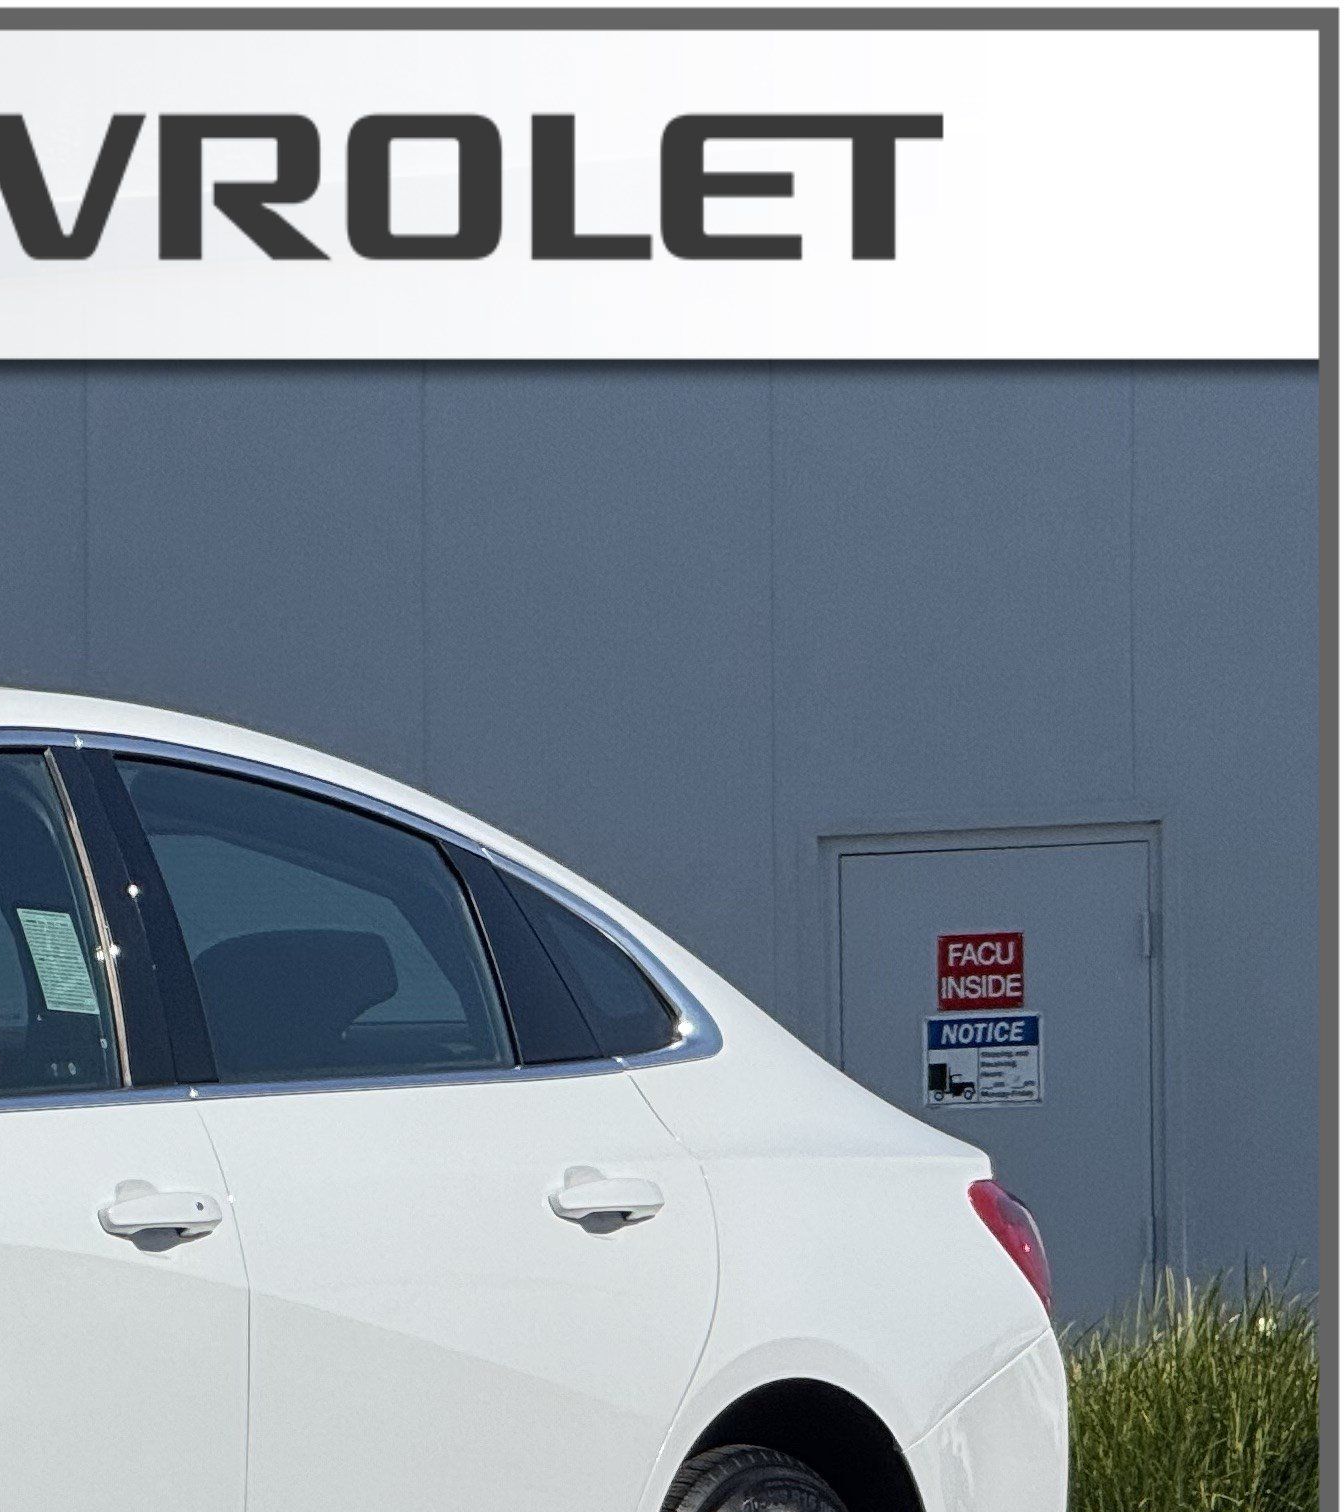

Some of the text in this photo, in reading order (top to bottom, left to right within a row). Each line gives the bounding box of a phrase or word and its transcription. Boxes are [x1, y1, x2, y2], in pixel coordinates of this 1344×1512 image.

[947, 941, 1015, 966] FACU
[941, 973, 1022, 999] INSIDE
[940, 1021, 1025, 1045] NOTICE
